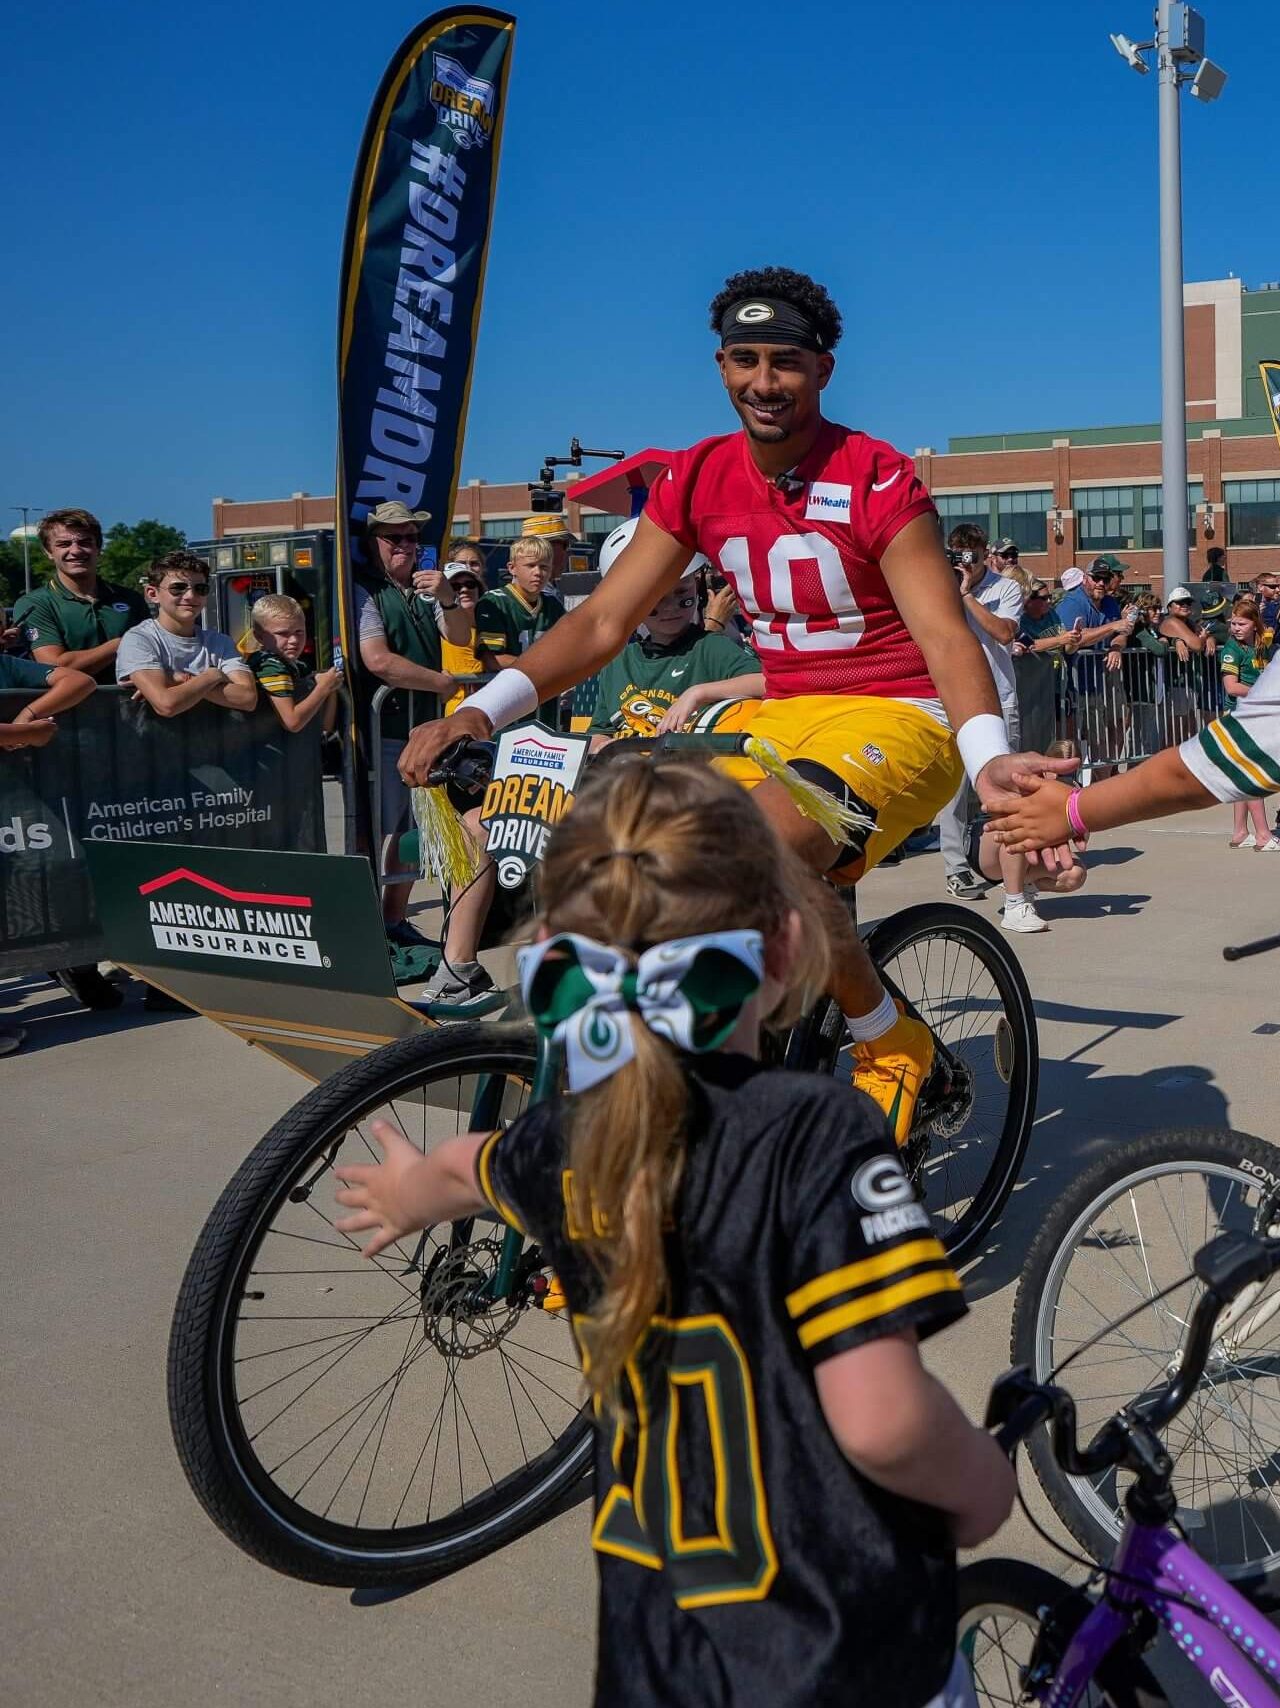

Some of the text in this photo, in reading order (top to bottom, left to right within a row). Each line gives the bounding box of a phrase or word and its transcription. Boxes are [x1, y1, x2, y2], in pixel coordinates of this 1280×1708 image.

[718, 531, 866, 651] 10
[512, 747, 567, 761] AMERICAN FAMILY
[514, 757, 560, 769] INSURANCE
[88, 787, 254, 819] American Family
[480, 775, 577, 825] DREAM
[90, 805, 272, 841] Children's Hospital
[486, 818, 552, 861] DRIVE
[150, 900, 313, 937] AMERICAN FAMILY
[166, 931, 306, 960] INSURANCE
